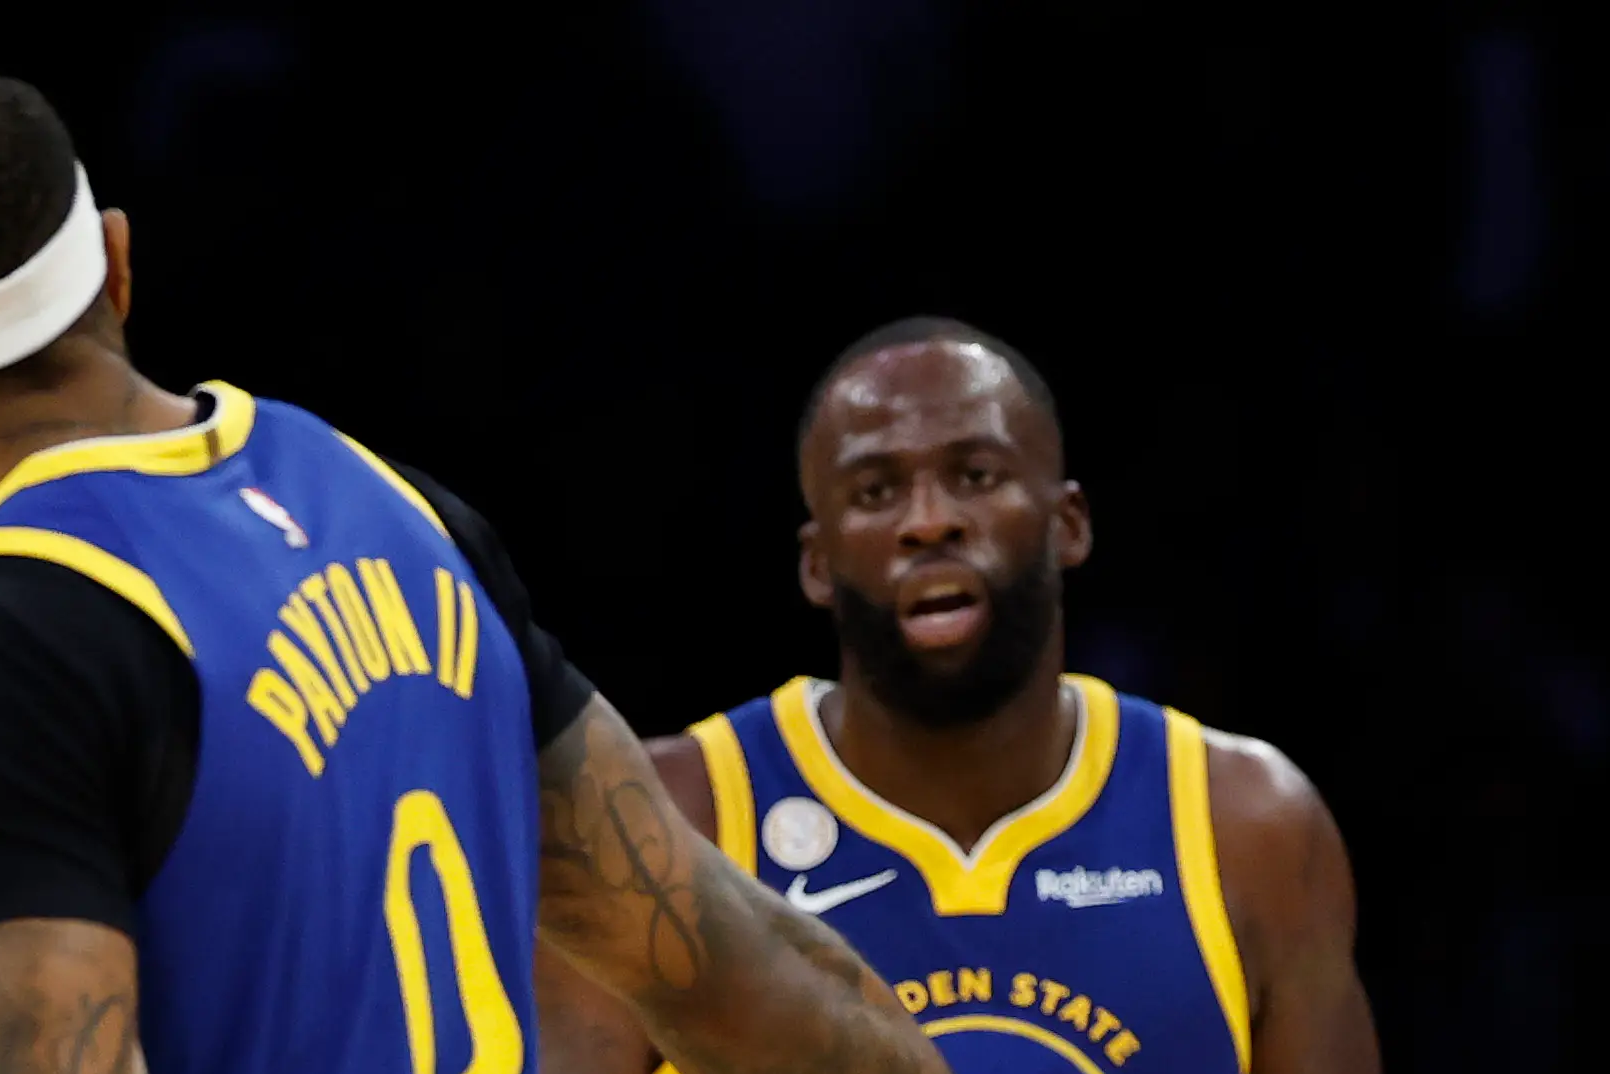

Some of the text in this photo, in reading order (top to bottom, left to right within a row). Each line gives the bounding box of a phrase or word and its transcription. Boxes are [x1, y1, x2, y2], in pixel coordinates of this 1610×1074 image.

[247, 557, 479, 777] PAYTON II
[1034, 865, 1164, 908] Rakuten
[894, 967, 1142, 1067] DEN STATE
